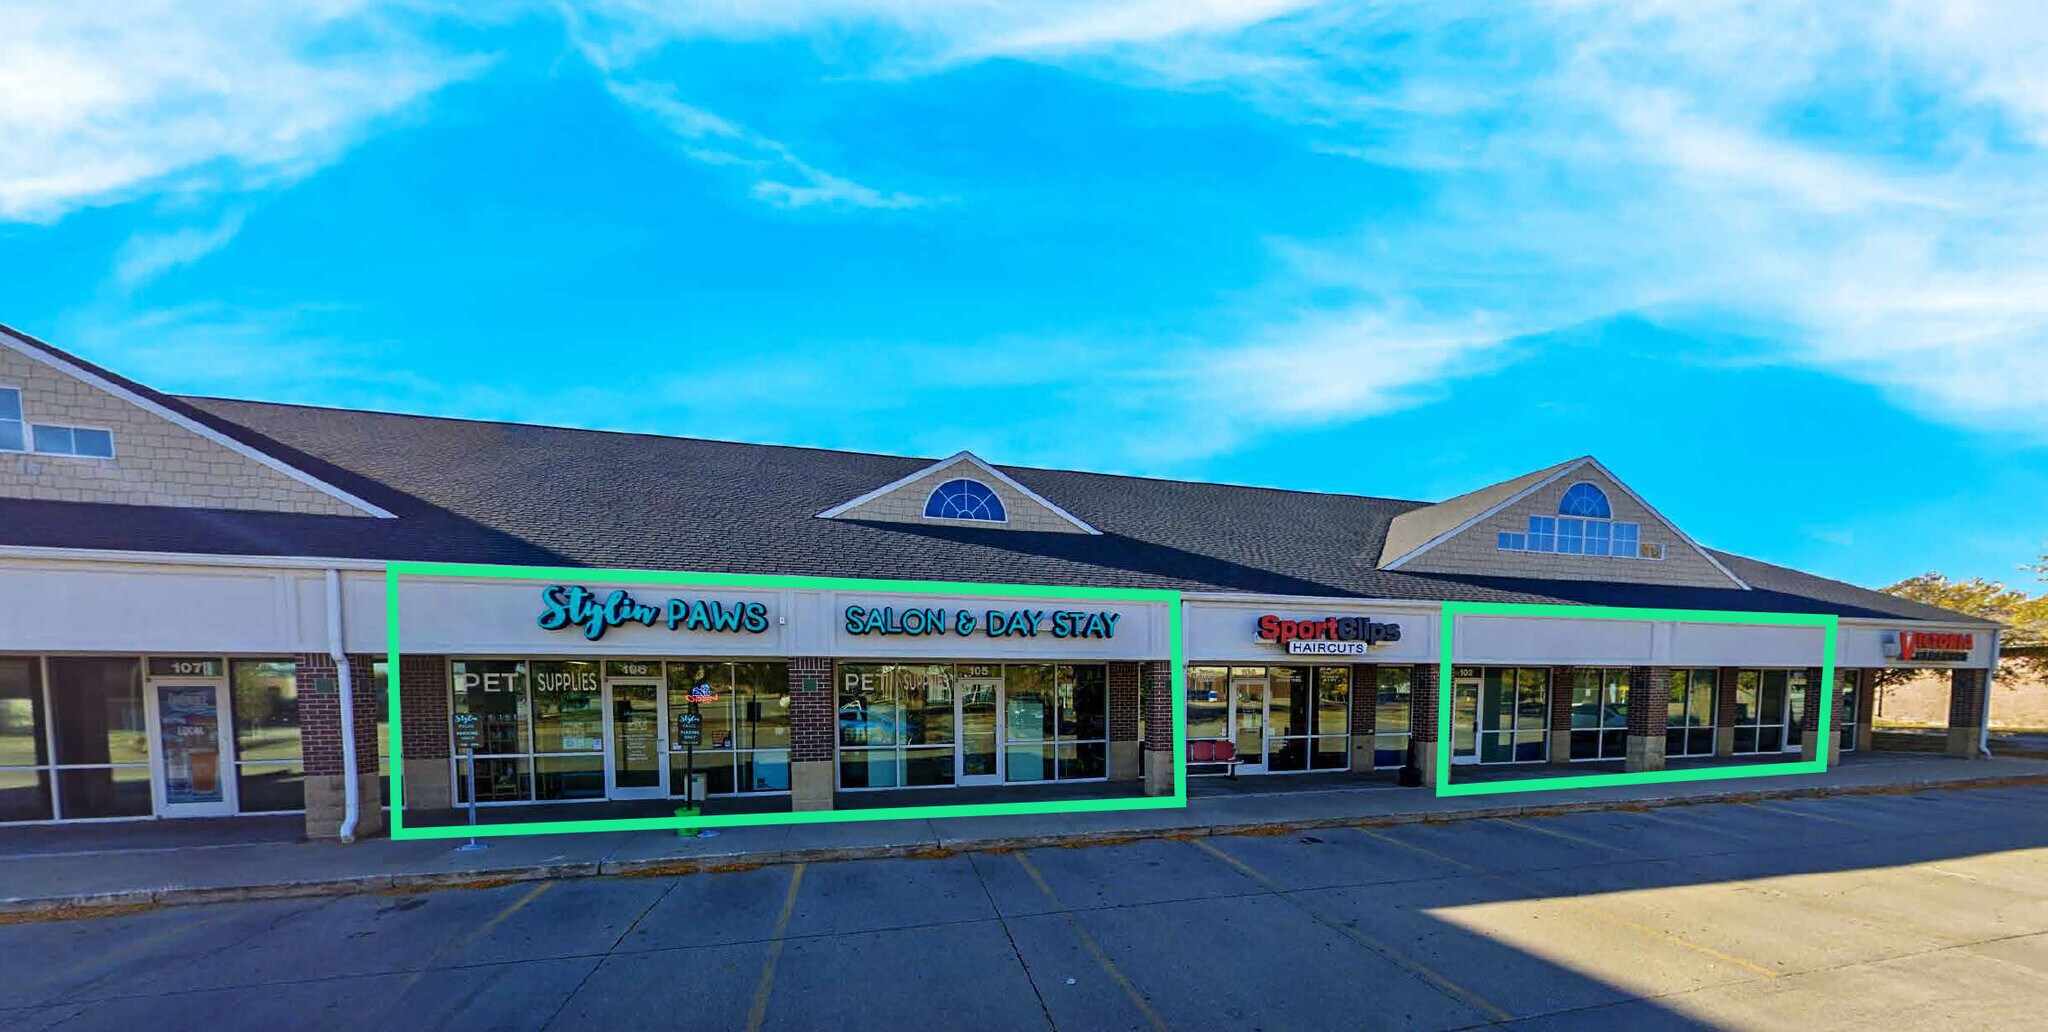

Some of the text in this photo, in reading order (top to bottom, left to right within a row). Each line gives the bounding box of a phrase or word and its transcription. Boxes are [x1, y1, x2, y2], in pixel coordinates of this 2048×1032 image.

[537, 585, 769, 641] Stylin PAWS
[845, 605, 1121, 638] SALON & DAY STAY
[1293, 643, 1365, 654] HAIRCUTS
[171, 662, 203, 674] 107
[969, 666, 988, 676] 105
[1460, 669, 1473, 677] 103
[464, 672, 598, 693] PET SUPPLIES
[845, 673, 887, 691] PET
[685, 694, 719, 703] OPEN
